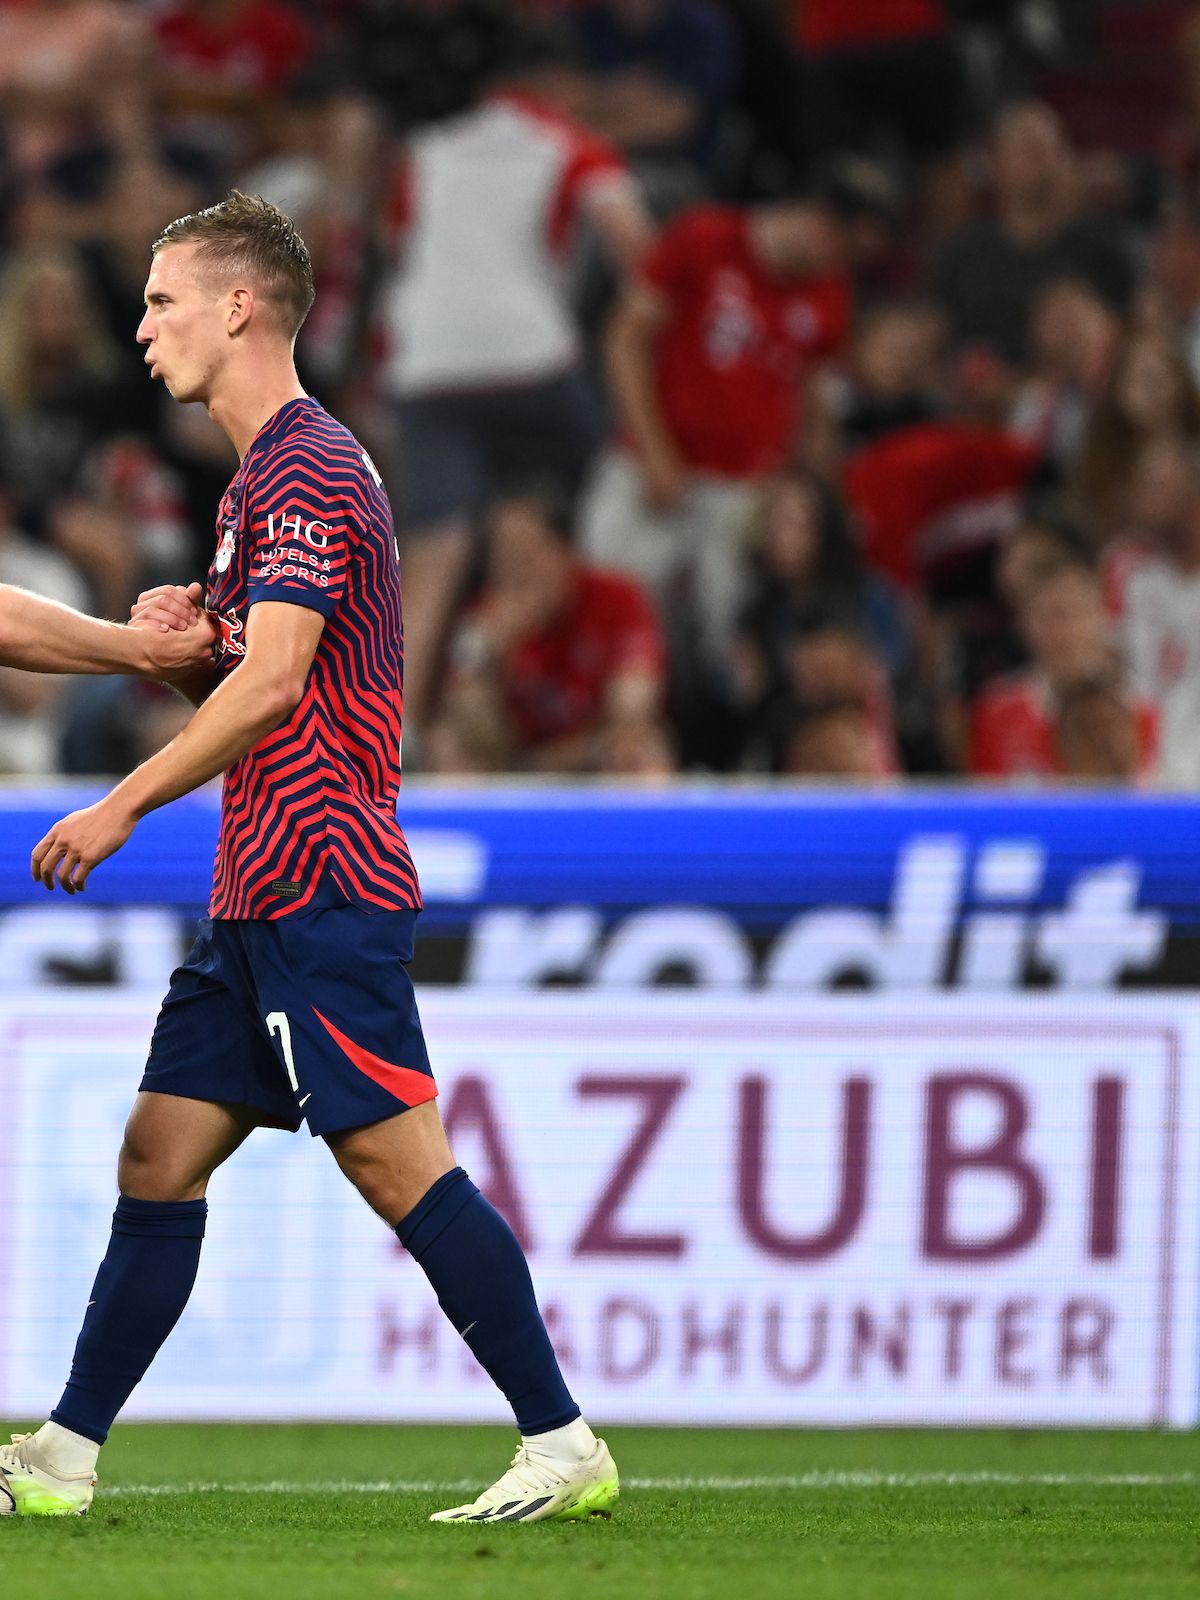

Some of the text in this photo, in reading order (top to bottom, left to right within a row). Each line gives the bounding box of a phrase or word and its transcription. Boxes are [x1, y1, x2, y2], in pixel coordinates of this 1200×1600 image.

[261, 546, 332, 572] HOTELS &
[267, 512, 329, 548] IHG
[265, 1011, 299, 1093] 7
[394, 1072, 1128, 1264] AZUBI
